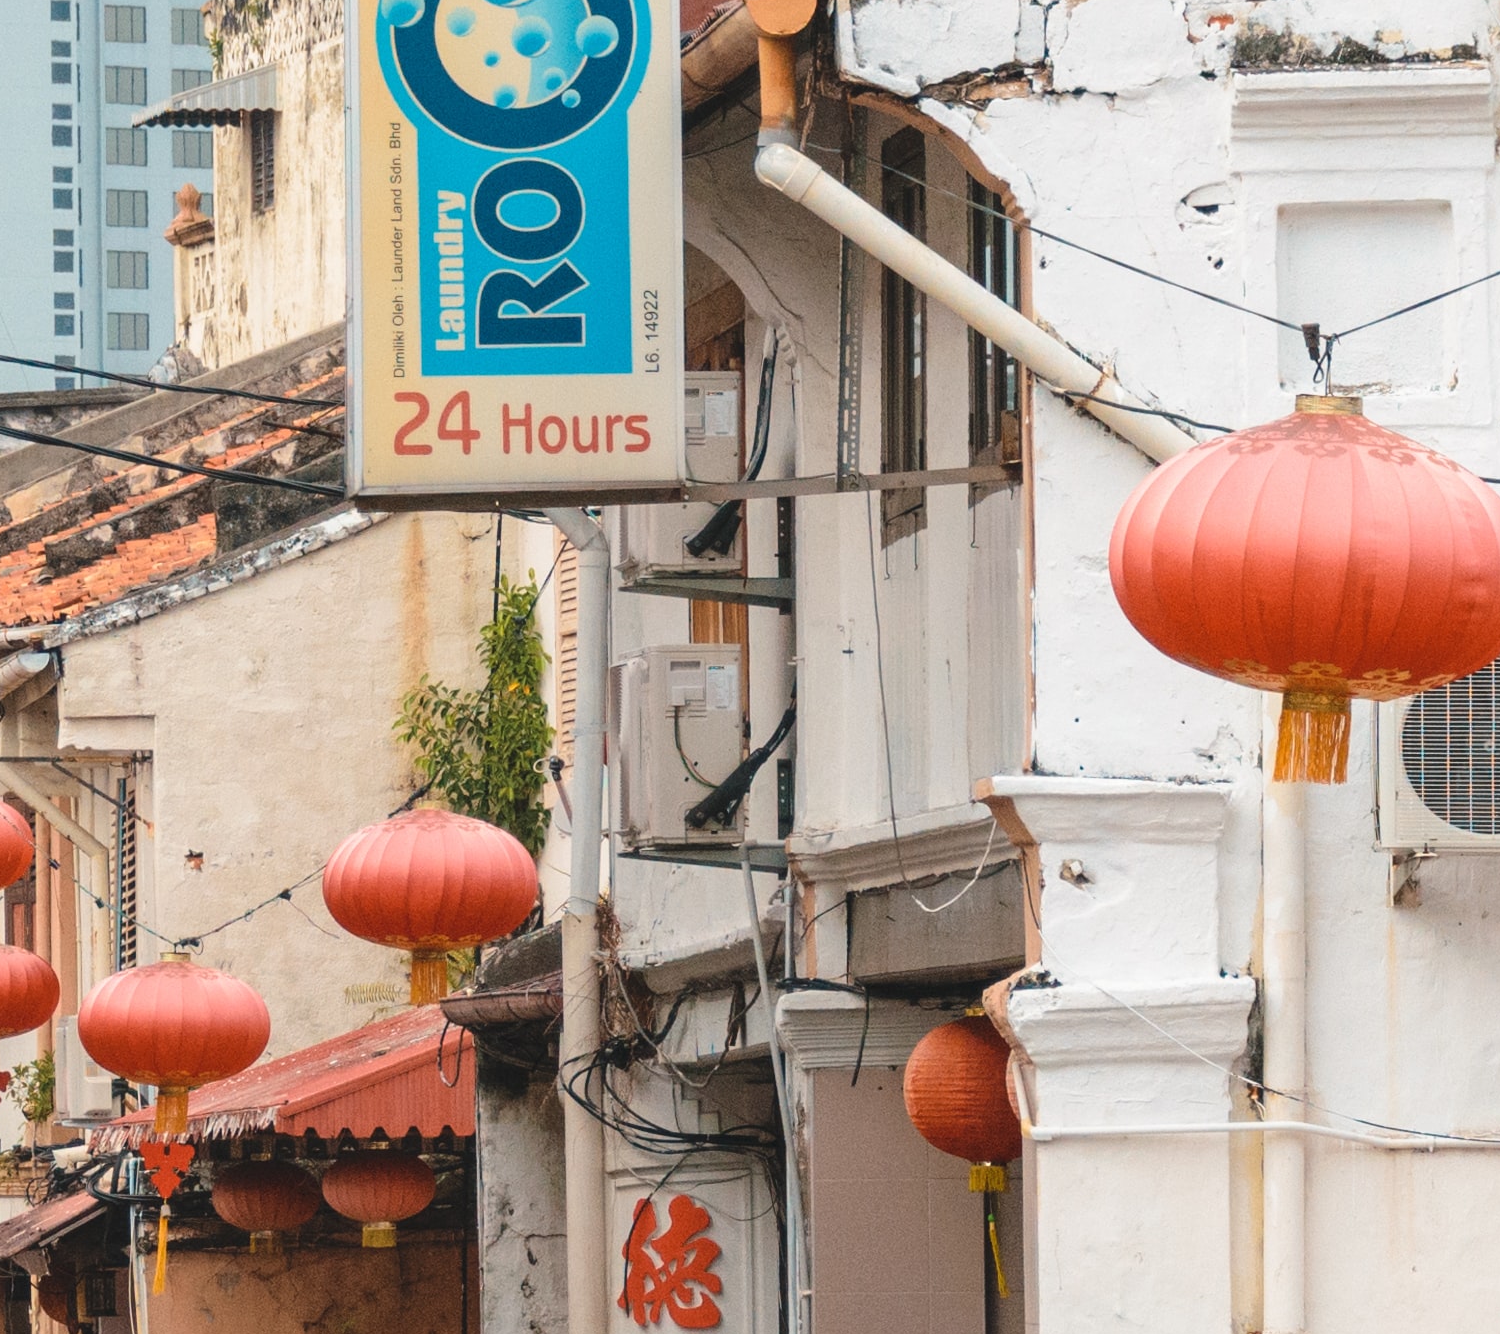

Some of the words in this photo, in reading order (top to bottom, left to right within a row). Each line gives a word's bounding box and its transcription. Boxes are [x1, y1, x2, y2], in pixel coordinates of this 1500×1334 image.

[389, 122, 401, 150] Bhd
[389, 153, 402, 185] Sdn.
[390, 187, 403, 223] Land
[391, 230, 404, 282] Launder
[433, 189, 467, 351] Laundry
[393, 294, 405, 323] Oleh
[643, 289, 659, 340] 14922
[393, 329, 405, 379] Dimiliki
[393, 391, 480, 456] 24
[502, 403, 652, 455] Hours
